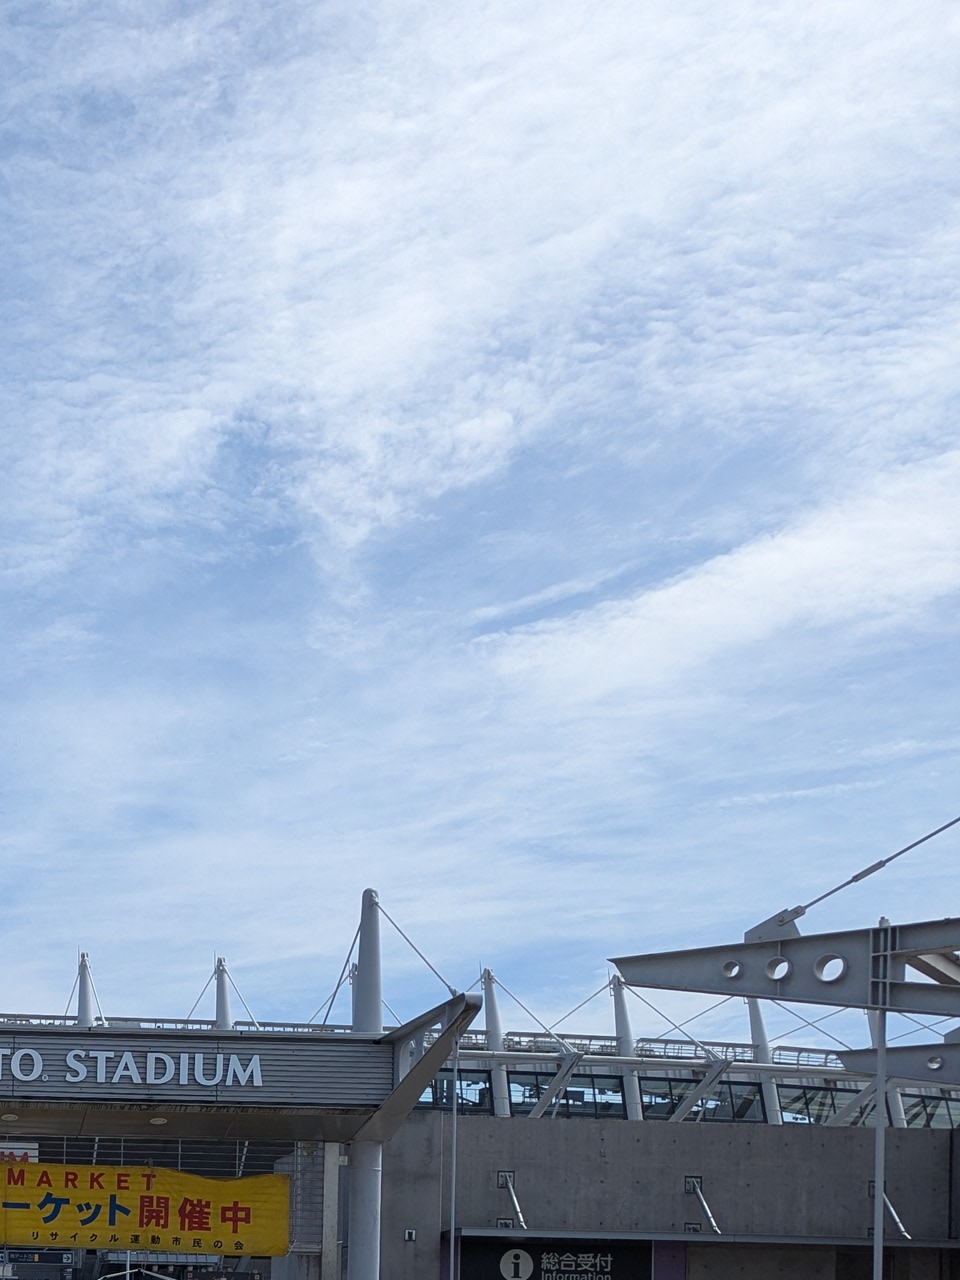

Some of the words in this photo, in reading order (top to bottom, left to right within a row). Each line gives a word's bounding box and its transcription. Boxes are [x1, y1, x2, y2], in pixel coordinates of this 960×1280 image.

[65, 1049, 263, 1087] STADIUM
[6, 1167, 157, 1191] MARKET
[31, 1230, 245, 1251] リサイクル運動市民の会
[540, 1252, 613, 1272] 総合受付
